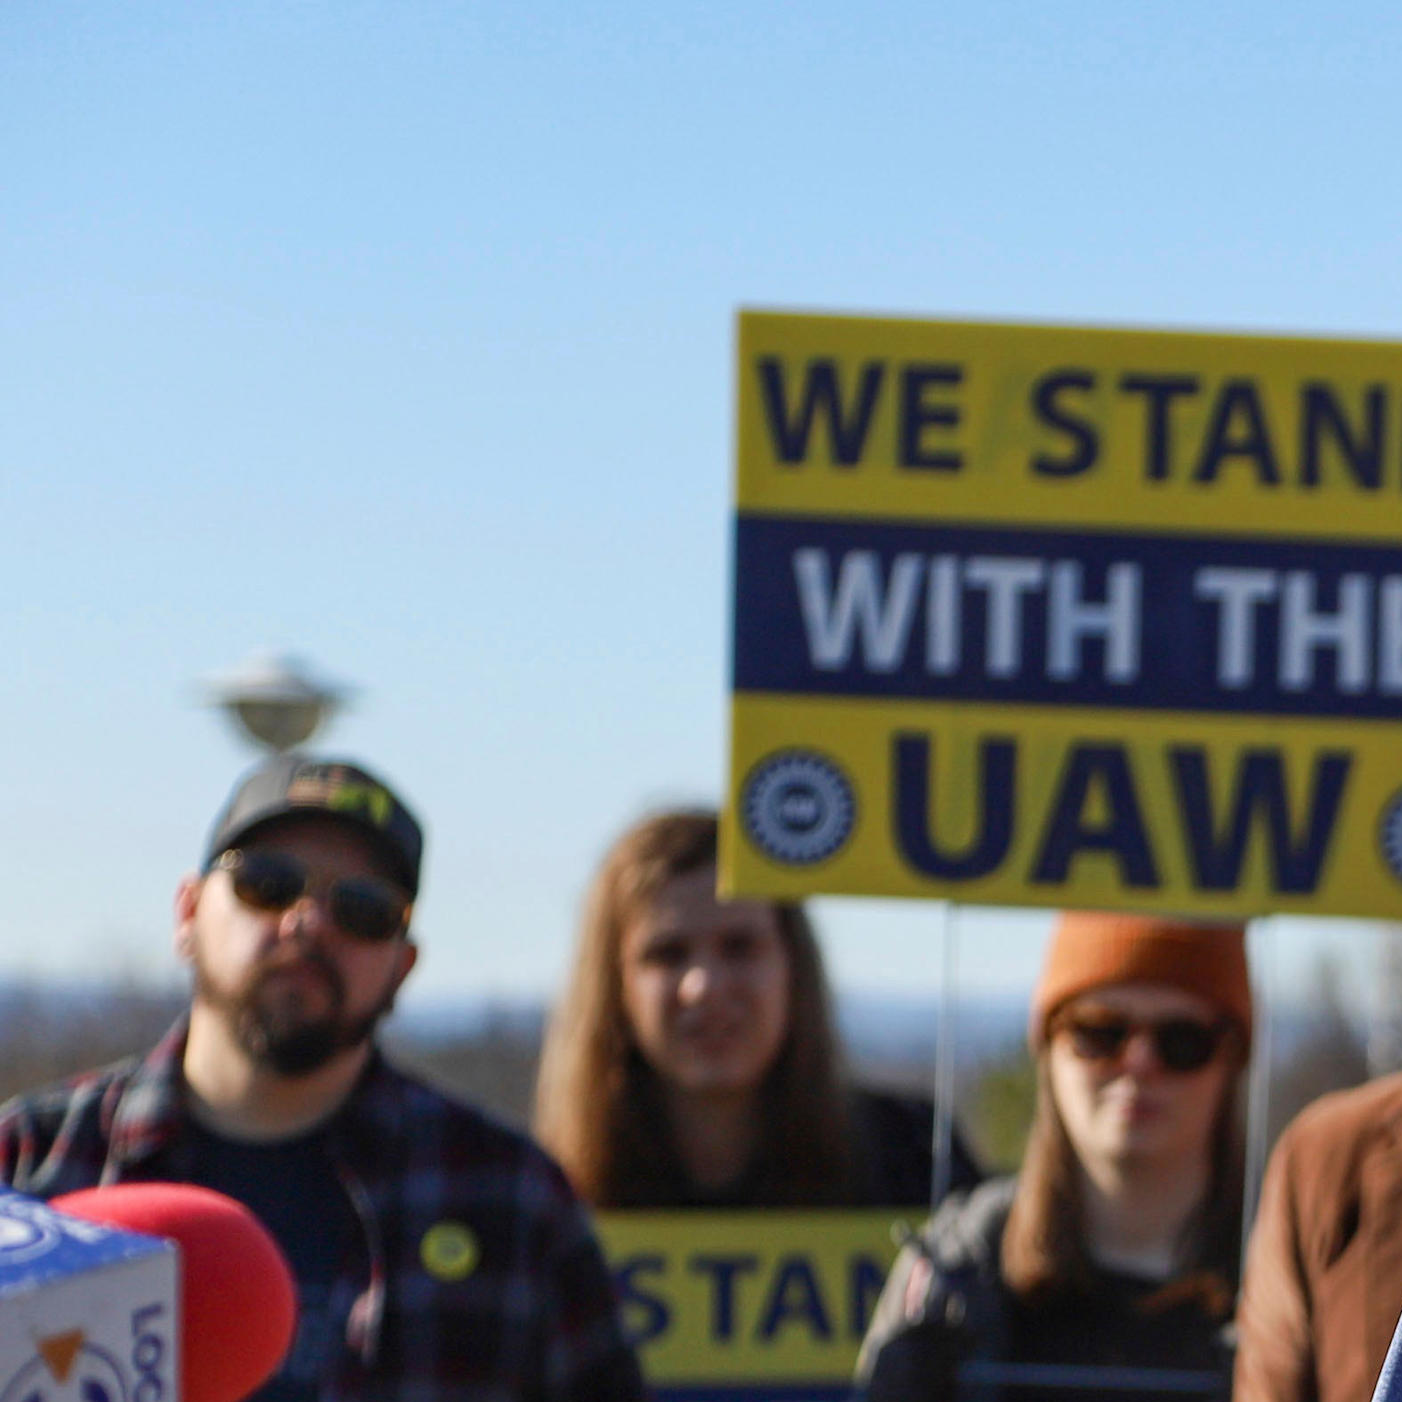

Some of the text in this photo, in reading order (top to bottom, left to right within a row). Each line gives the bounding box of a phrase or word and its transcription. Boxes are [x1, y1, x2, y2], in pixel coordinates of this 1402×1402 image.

[756, 355, 967, 473] WE
[794, 546, 1143, 686] WITH
[889, 729, 1357, 897] UAW
[612, 1250, 890, 1345] STAN
